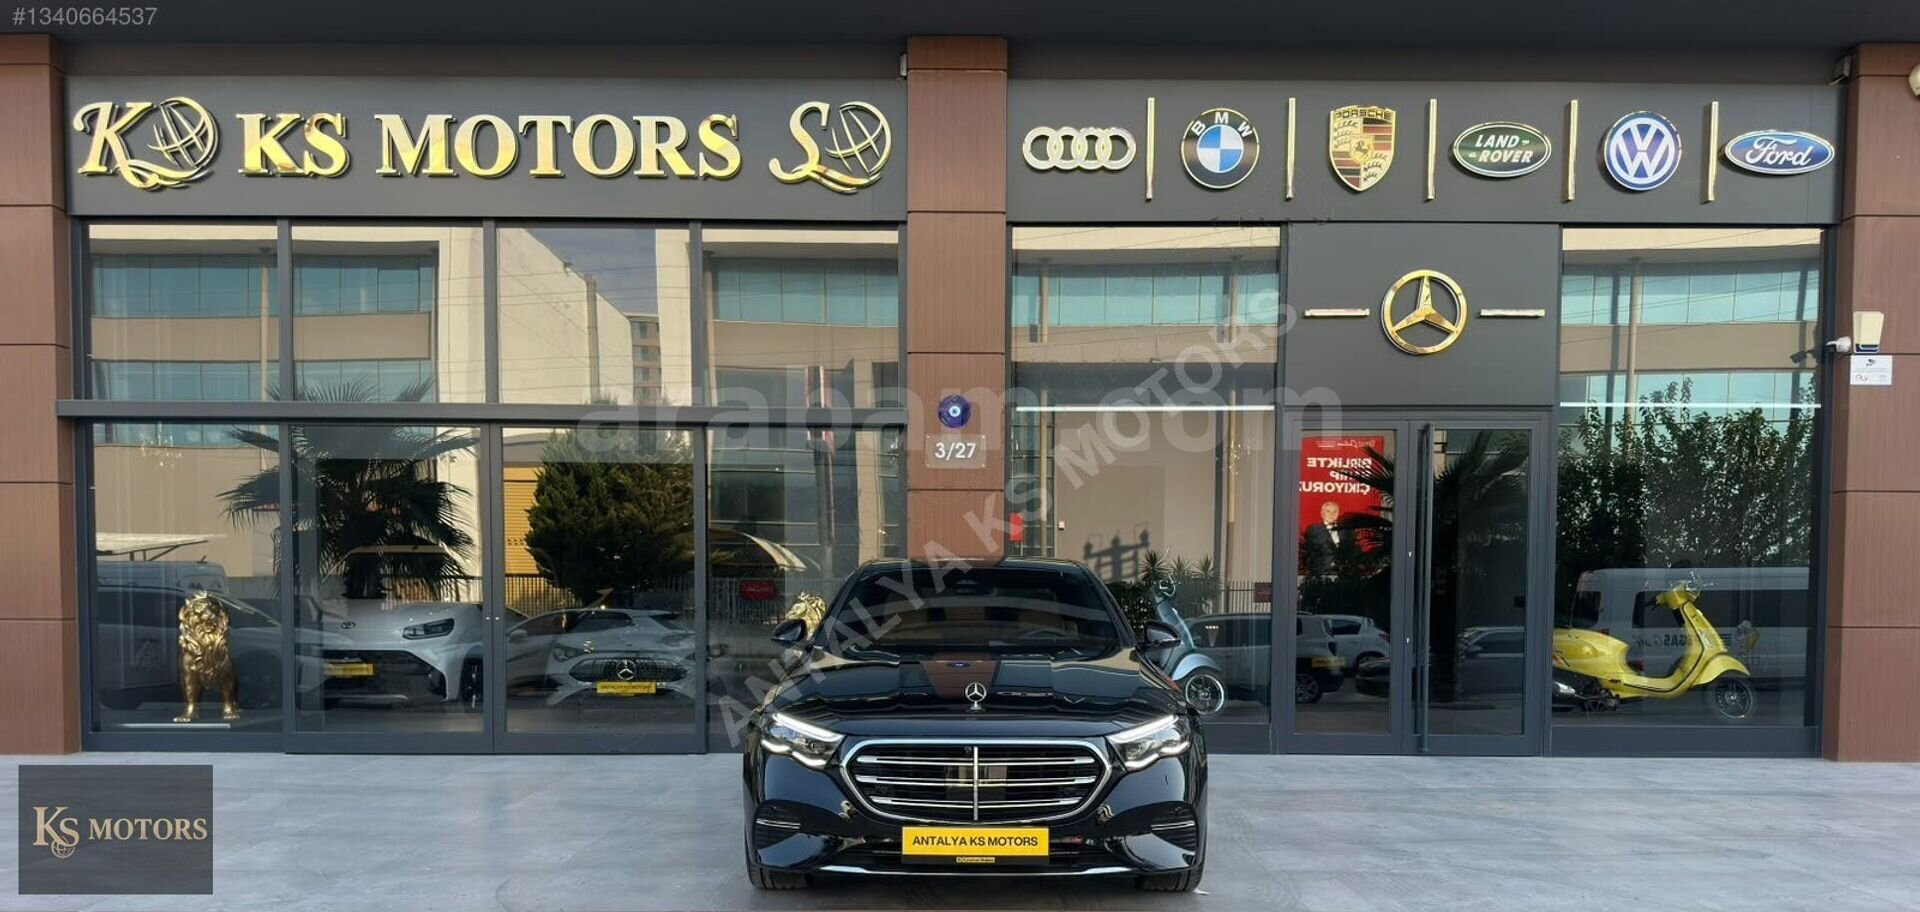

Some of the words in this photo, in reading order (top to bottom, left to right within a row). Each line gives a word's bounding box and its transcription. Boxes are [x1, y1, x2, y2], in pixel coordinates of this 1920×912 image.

[1335, 107, 1392, 120] PORSCHE
[1190, 111, 1253, 138] BMW
[236, 112, 350, 178] KS
[375, 113, 742, 180] MOTORS
[1475, 133, 1520, 149] LAND
[1478, 150, 1534, 164] ROVER
[1745, 135, 1816, 167] Ford
[935, 441, 976, 461] 3/27
[912, 835, 967, 846] ANTALYA
[969, 836, 985, 847] KS
[987, 836, 1038, 847] MOTORS
